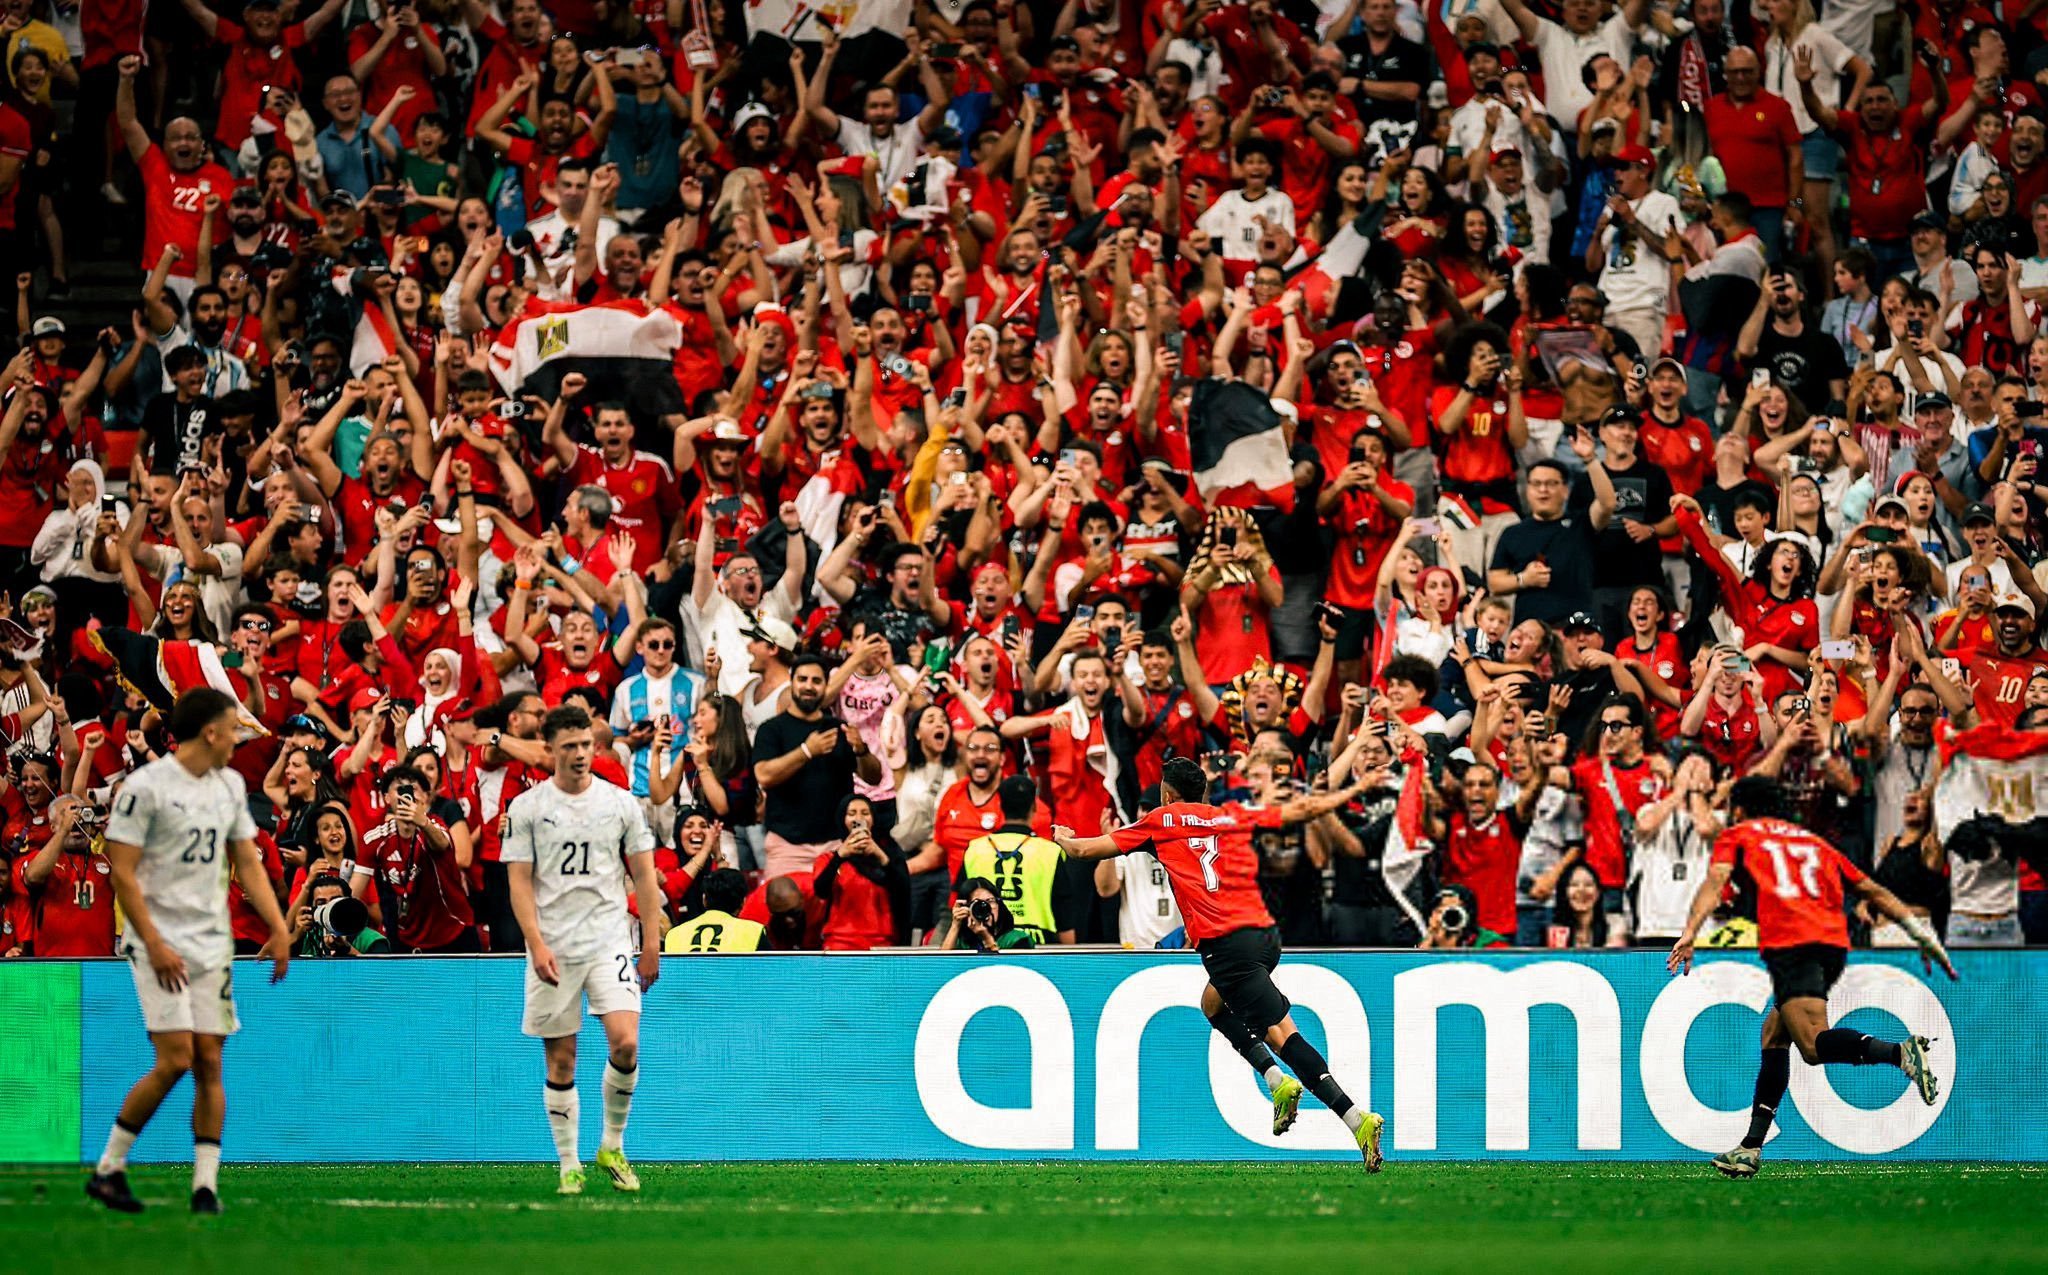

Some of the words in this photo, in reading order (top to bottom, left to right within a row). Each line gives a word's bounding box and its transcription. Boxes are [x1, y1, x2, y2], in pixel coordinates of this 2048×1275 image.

[172, 187, 200, 212] 22
[179, 409, 206, 469] didas
[1472, 412, 1491, 436] 10
[1996, 676, 2023, 704] 10
[181, 826, 217, 864] 23
[560, 841, 592, 876] 21
[1188, 834, 1220, 892] 7
[1760, 839, 1821, 899] 17
[615, 954, 636, 983] 2
[915, 962, 1957, 1155] aramco
